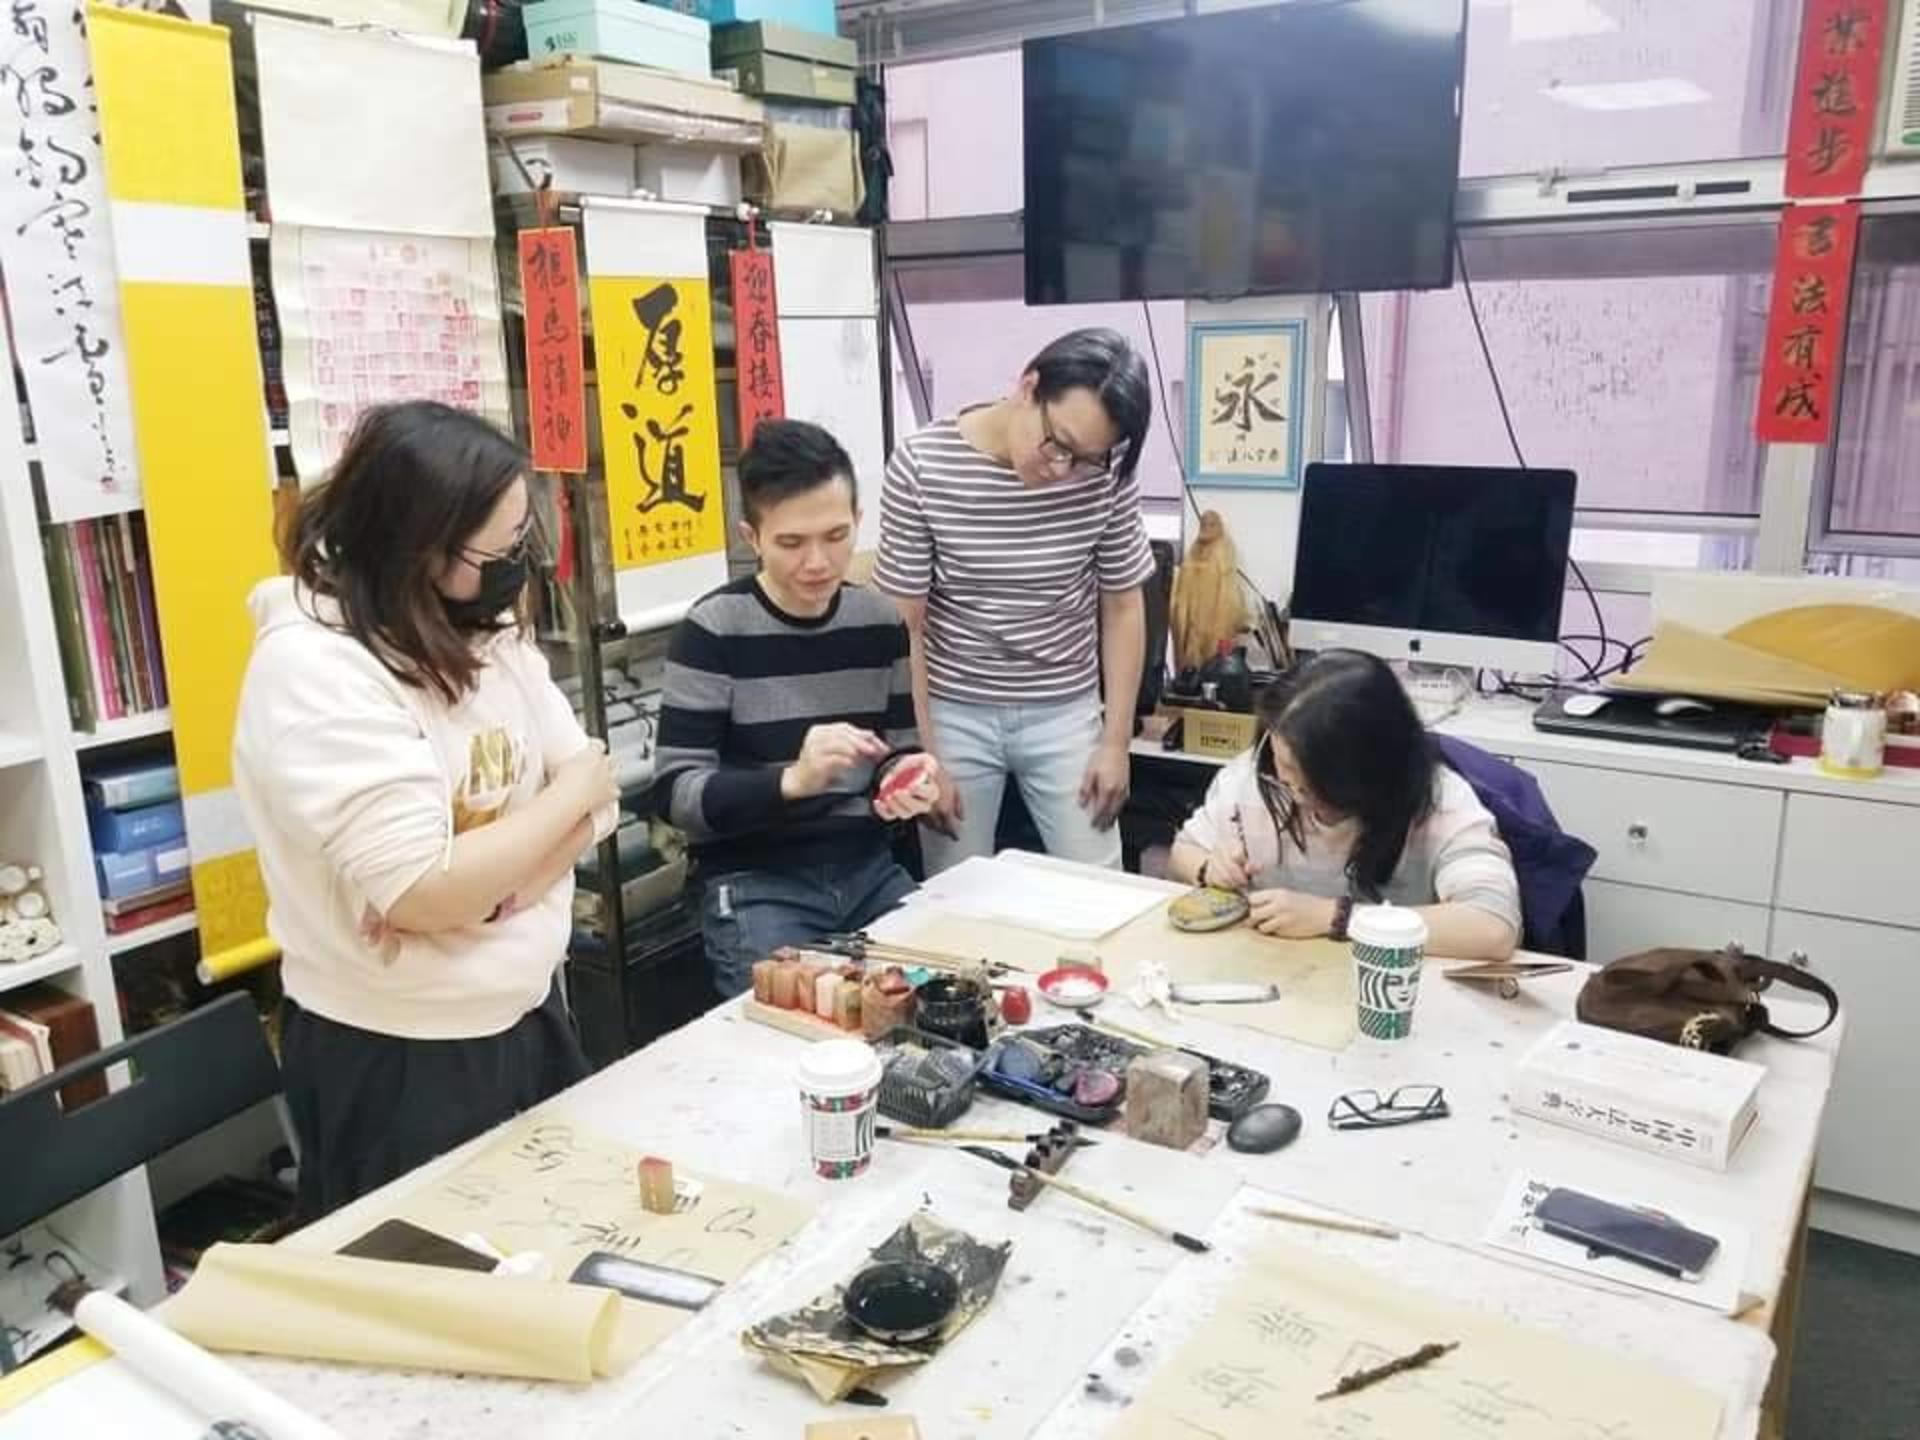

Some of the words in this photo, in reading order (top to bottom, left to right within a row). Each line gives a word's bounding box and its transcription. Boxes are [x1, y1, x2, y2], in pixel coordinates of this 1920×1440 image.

[620, 283, 707, 514] 厚道
[743, 260, 777, 420] 迎春接
[1211, 354, 1287, 433] 永
